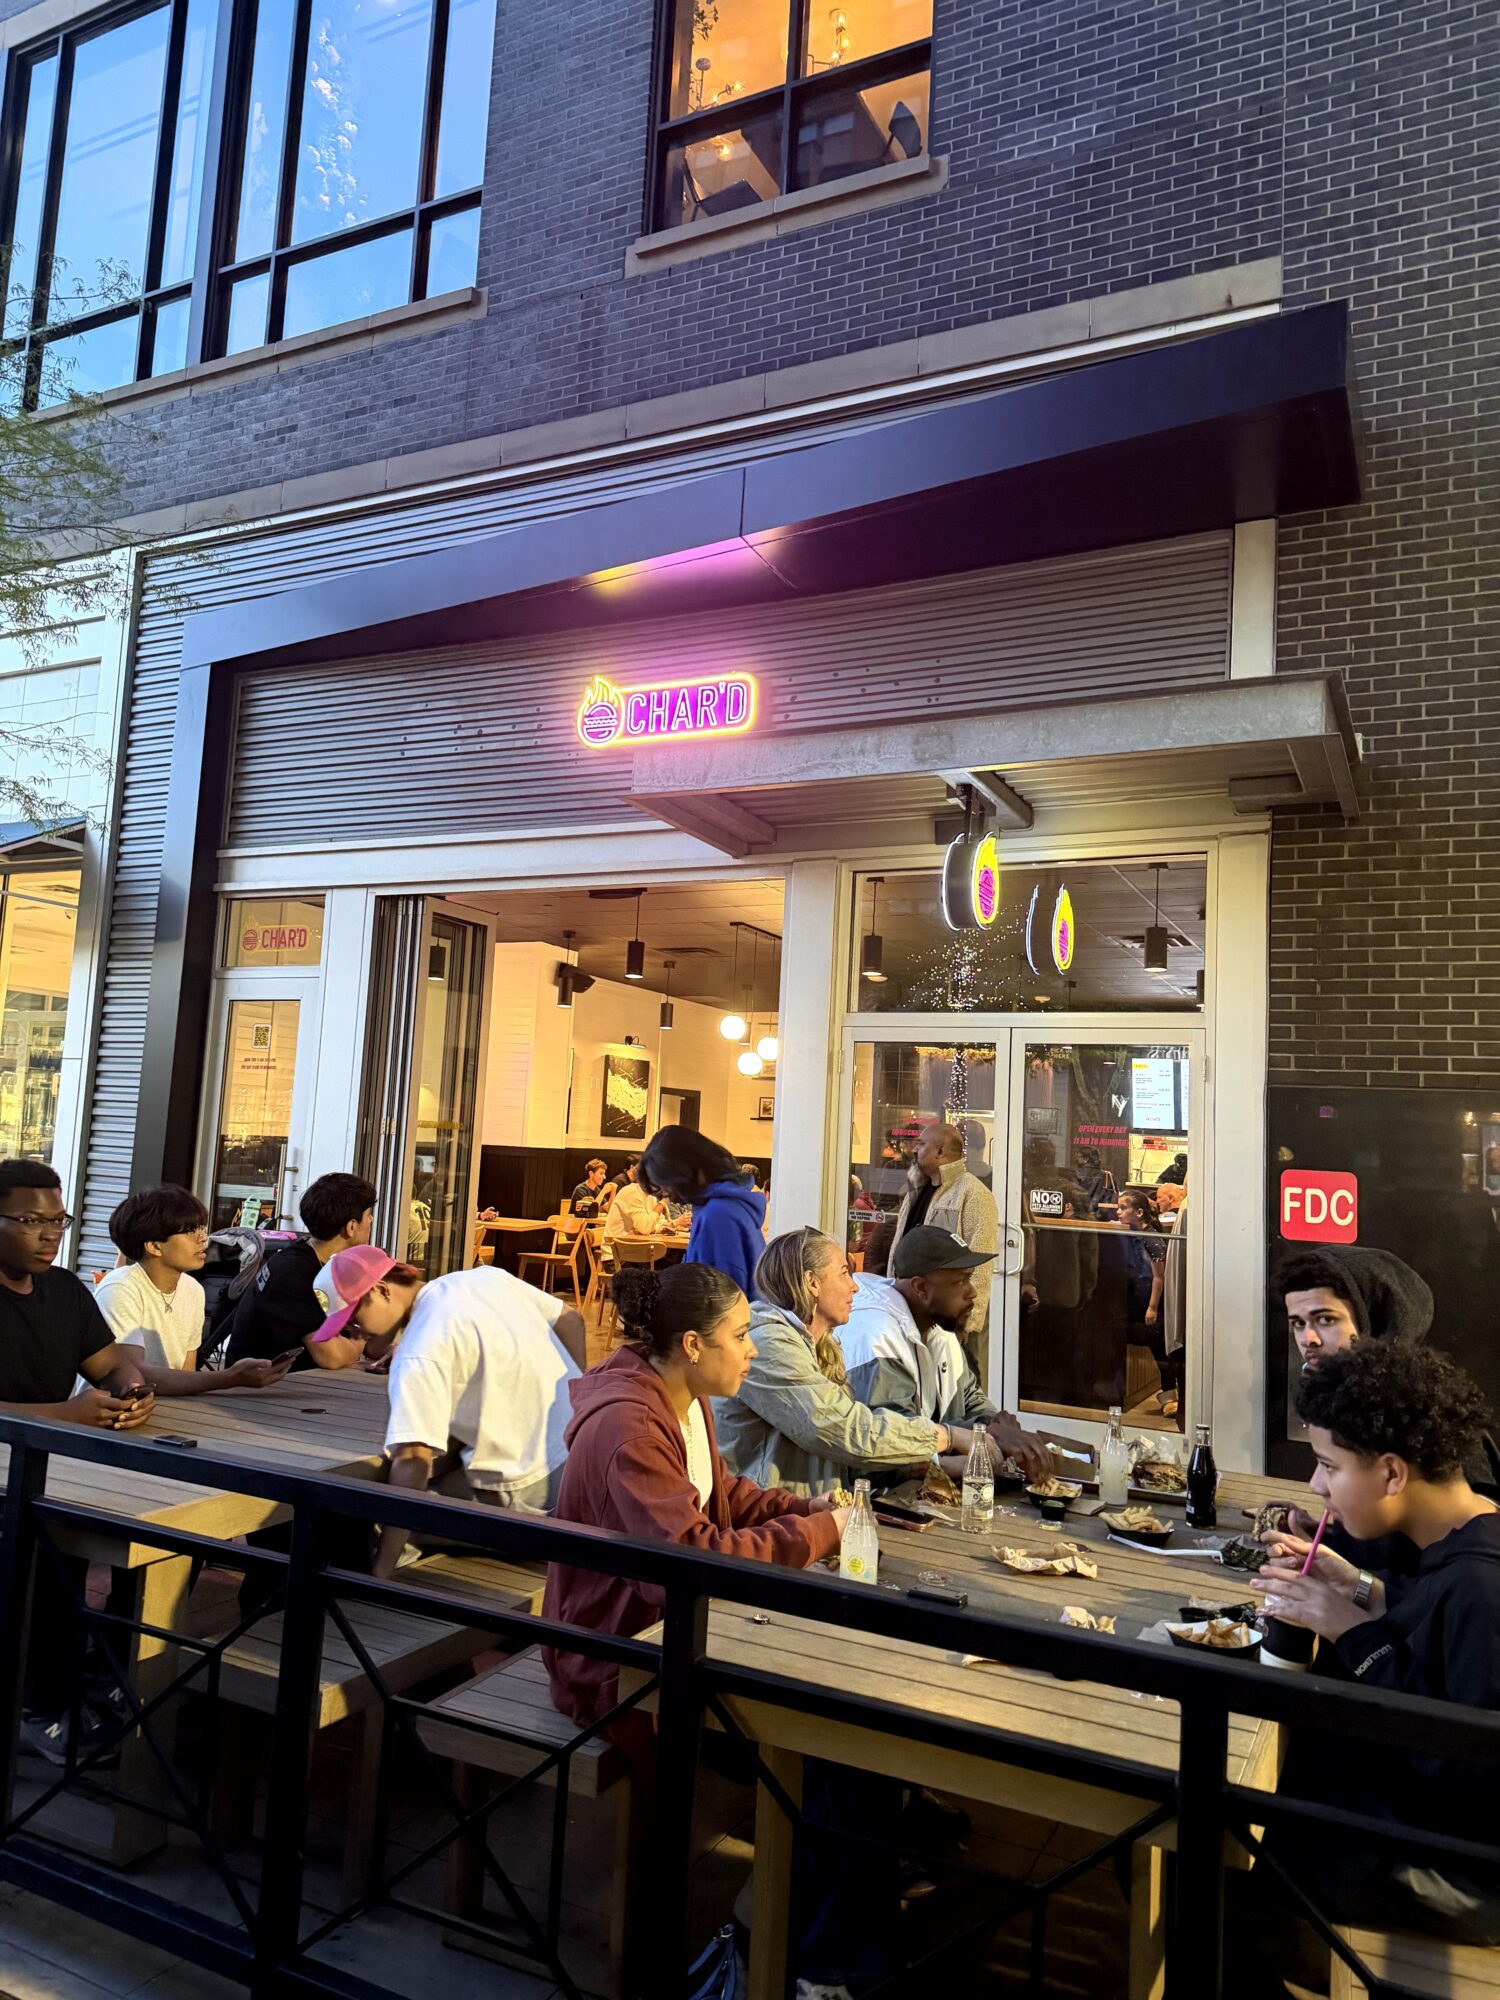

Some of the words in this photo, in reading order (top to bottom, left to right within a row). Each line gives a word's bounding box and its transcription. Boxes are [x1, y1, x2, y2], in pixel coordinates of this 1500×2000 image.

[626, 682, 748, 735] CHAR'D
[262, 928, 307, 948] CHAR'D
[1079, 1137, 1090, 1145] AM
[1090, 1138, 1099, 1146] TO
[1032, 1191, 1050, 1204] NO
[1283, 1186, 1354, 1226] FDC
